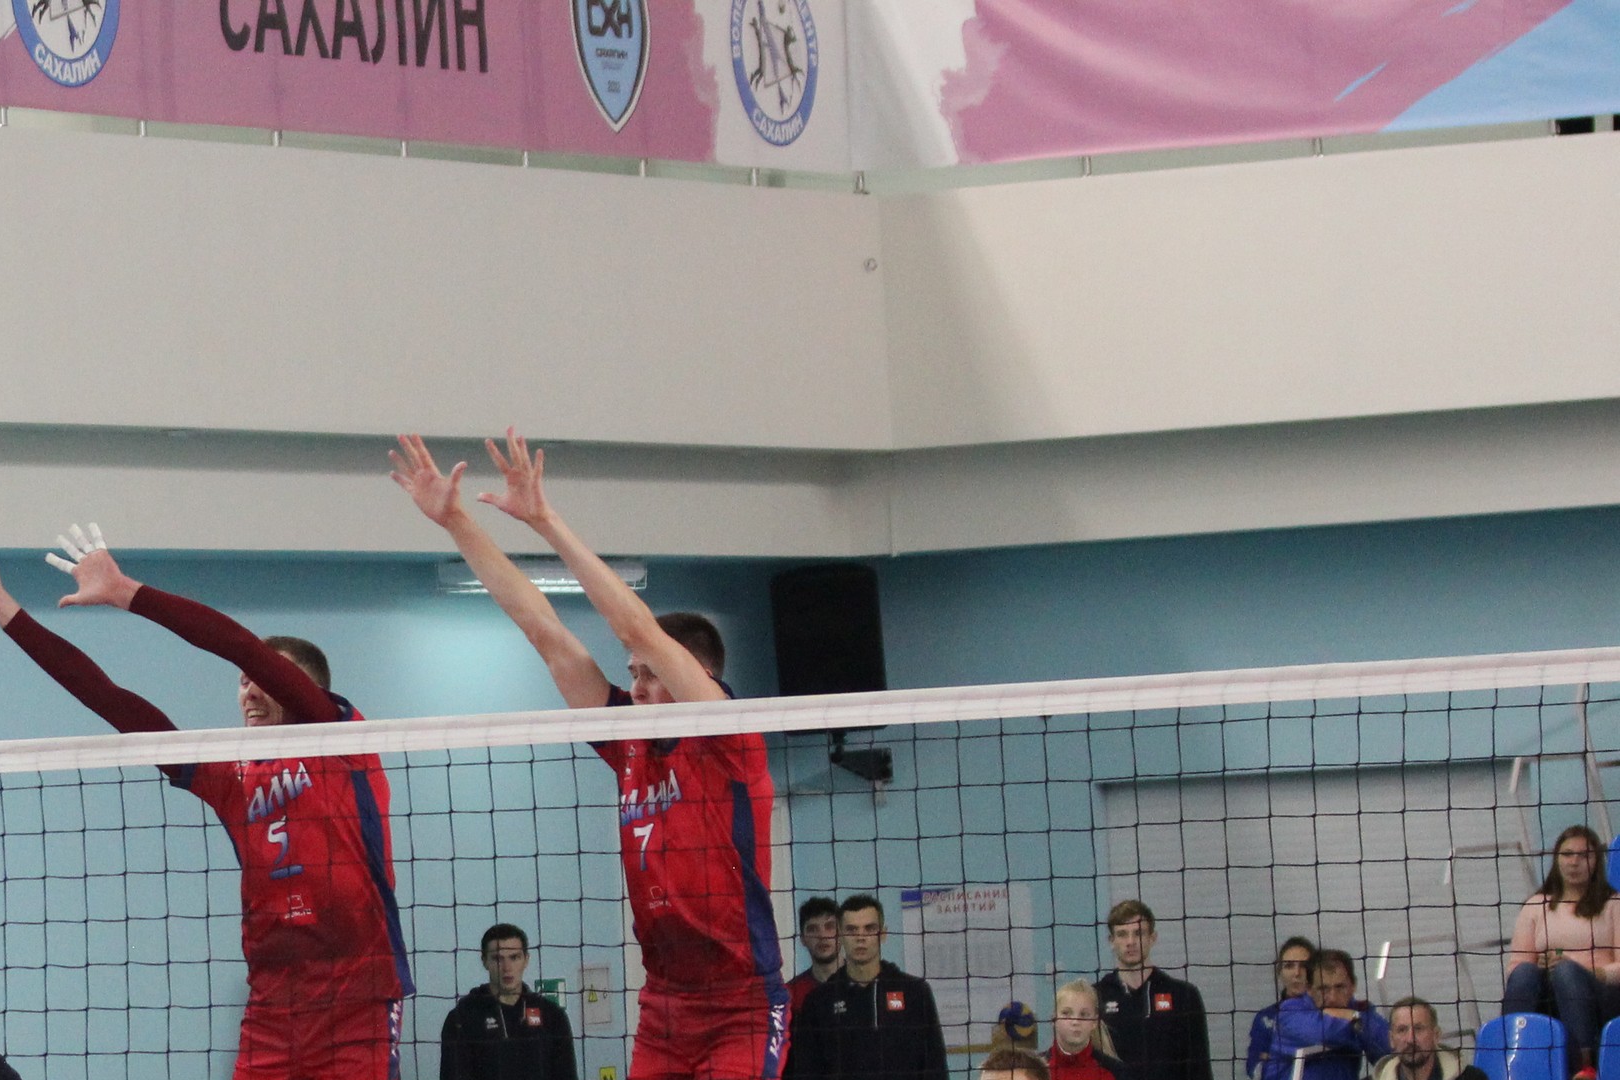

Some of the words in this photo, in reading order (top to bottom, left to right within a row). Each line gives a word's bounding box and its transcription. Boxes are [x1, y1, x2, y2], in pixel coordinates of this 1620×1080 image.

[220, 0, 488, 73] САХАЛИН
[34, 43, 102, 83] САХАЛИН
[247, 761, 313, 825] АМА
[267, 815, 289, 865] 5
[633, 822, 655, 871] 7
